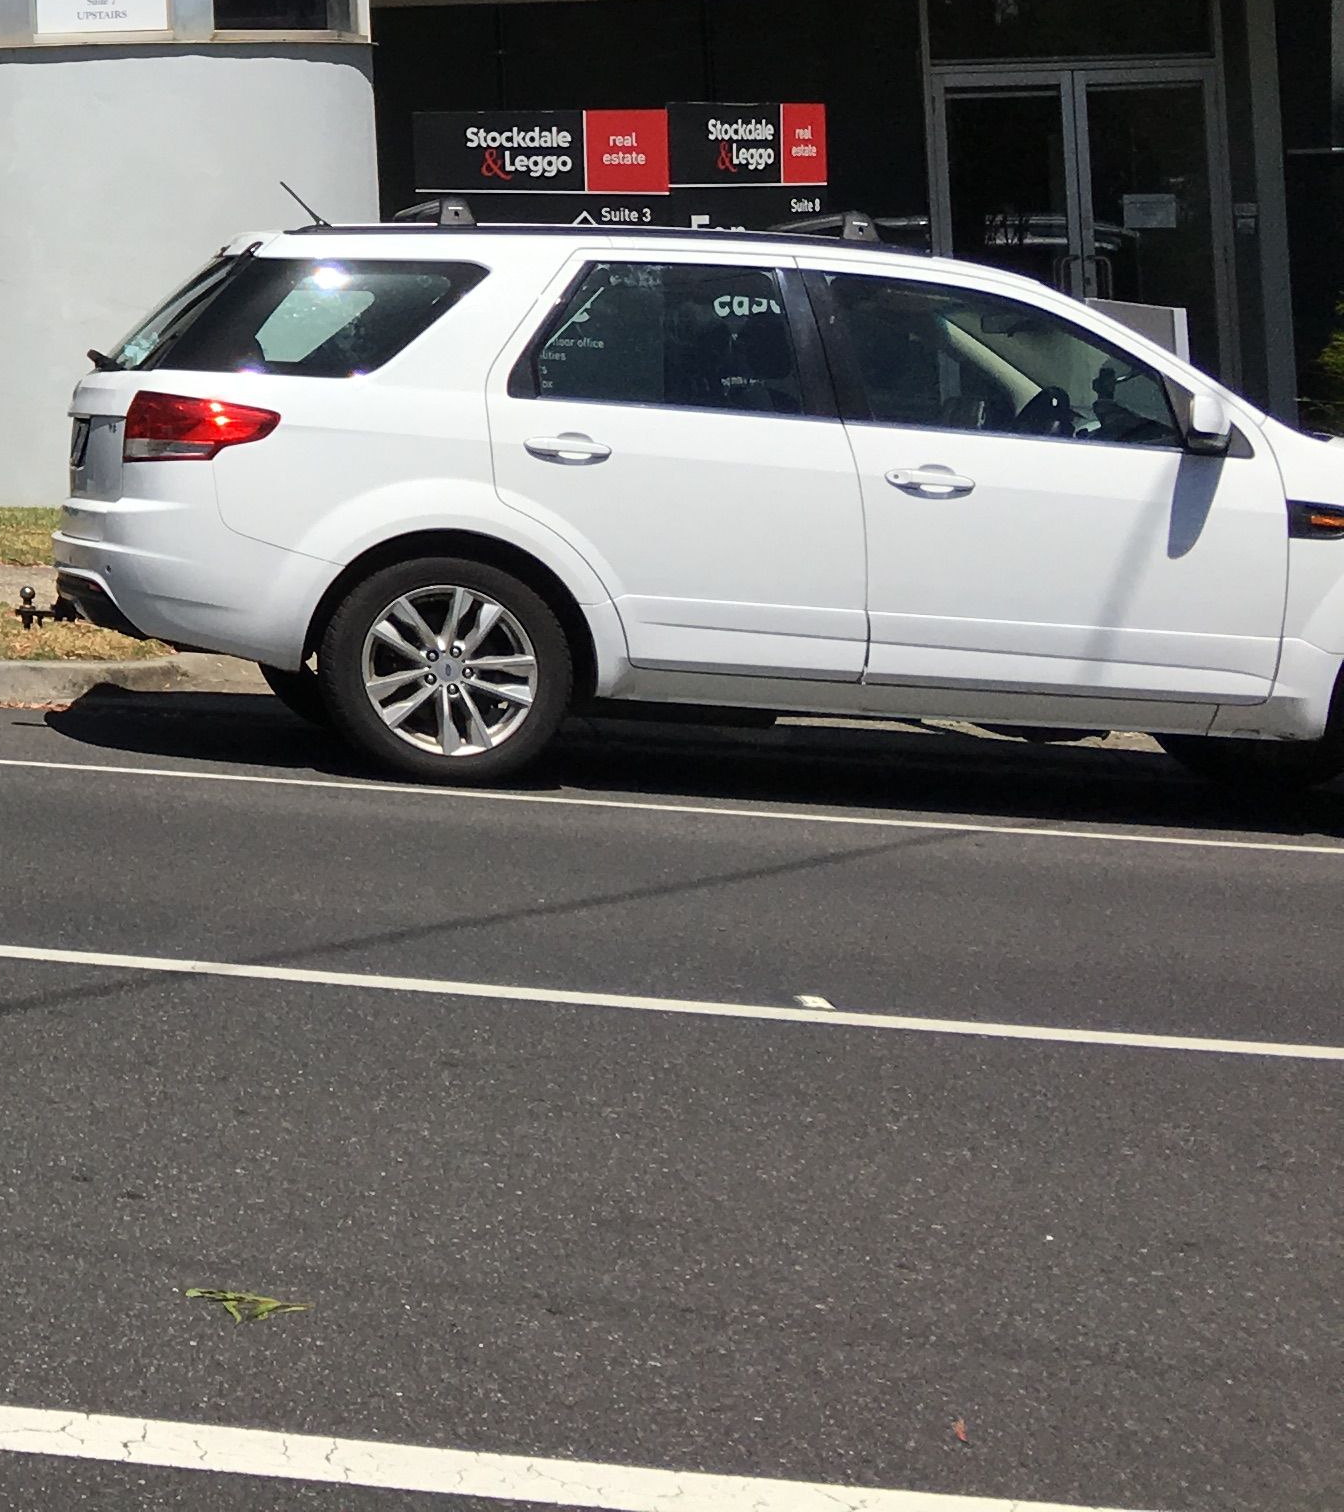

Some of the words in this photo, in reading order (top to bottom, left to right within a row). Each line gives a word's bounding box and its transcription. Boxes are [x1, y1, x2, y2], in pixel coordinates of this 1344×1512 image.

[76, 9, 128, 21] UPSTAIRS
[707, 118, 775, 140] Stockdale
[795, 125, 813, 139] real
[465, 126, 572, 148] Stockdale
[609, 132, 638, 147] real
[602, 151, 646, 165] estate
[791, 144, 817, 157] estate
[790, 198, 814, 213] Suite
[814, 197, 821, 212] 8
[600, 207, 639, 222] Suite
[642, 207, 652, 222] 3
